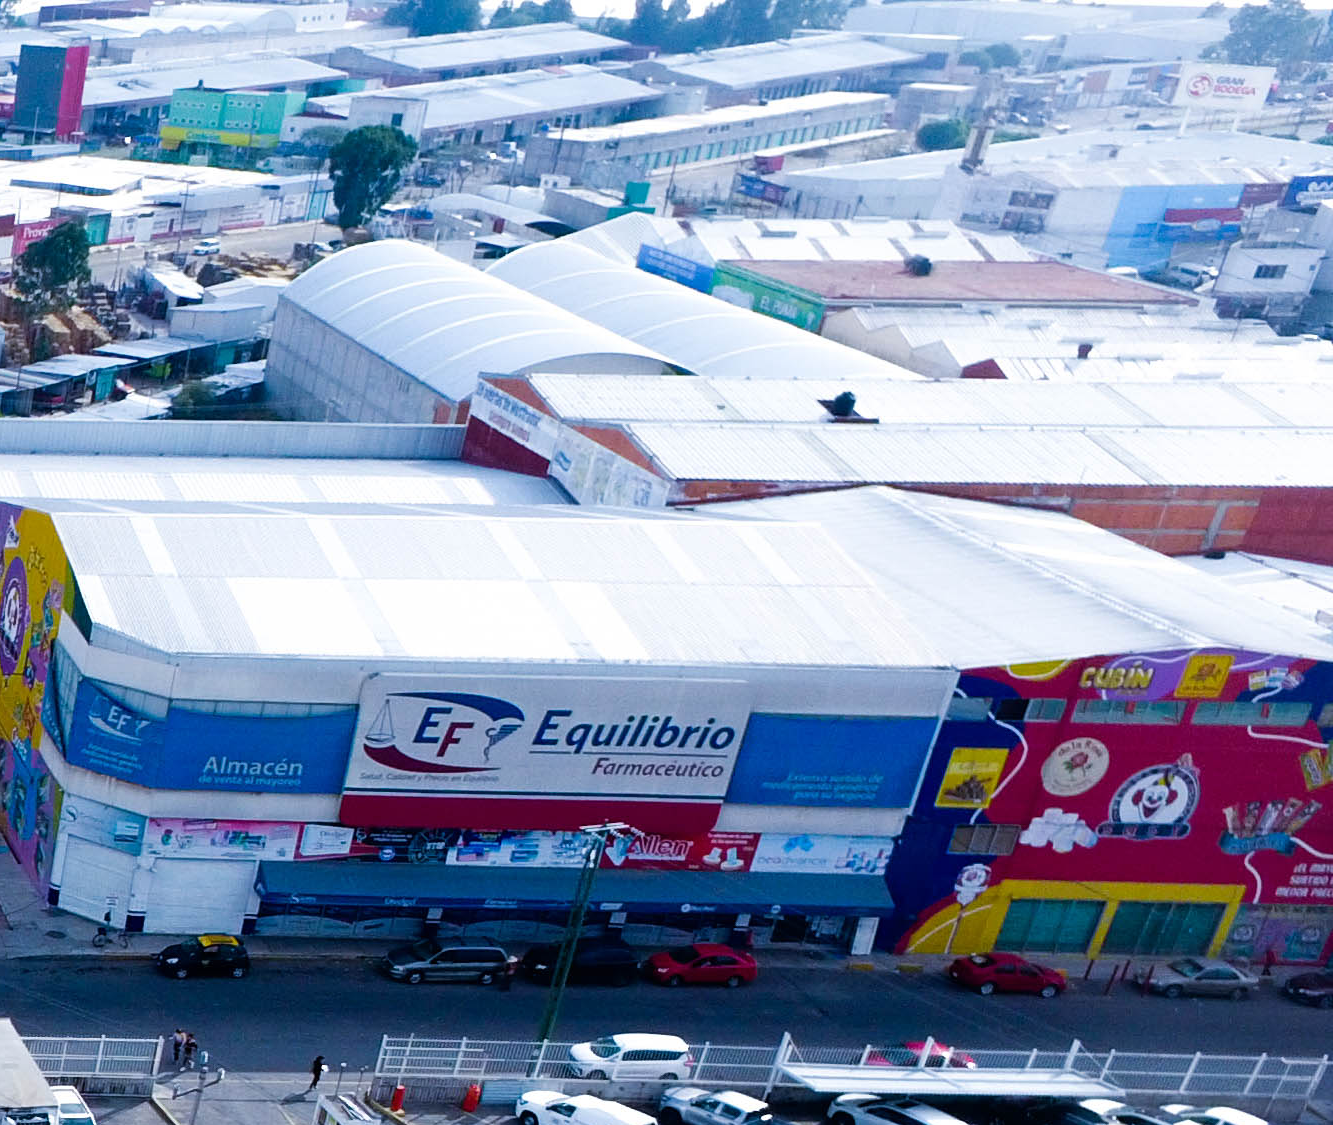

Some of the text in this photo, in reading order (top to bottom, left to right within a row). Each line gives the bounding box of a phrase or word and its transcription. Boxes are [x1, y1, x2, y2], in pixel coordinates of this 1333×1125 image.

[1214, 84, 1256, 95] BODEGA
[1217, 76, 1245, 85] GRAN
[1079, 660, 1155, 689] CUBÍN
[533, 709, 735, 753] Equilibrio
[203, 756, 303, 777] Almacén
[591, 757, 724, 779] Farmacéutico
[198, 775, 210, 784] de
[213, 776, 242, 785] venta
[255, 777, 301, 787] mayoreo
[631, 832, 692, 857] Allen
